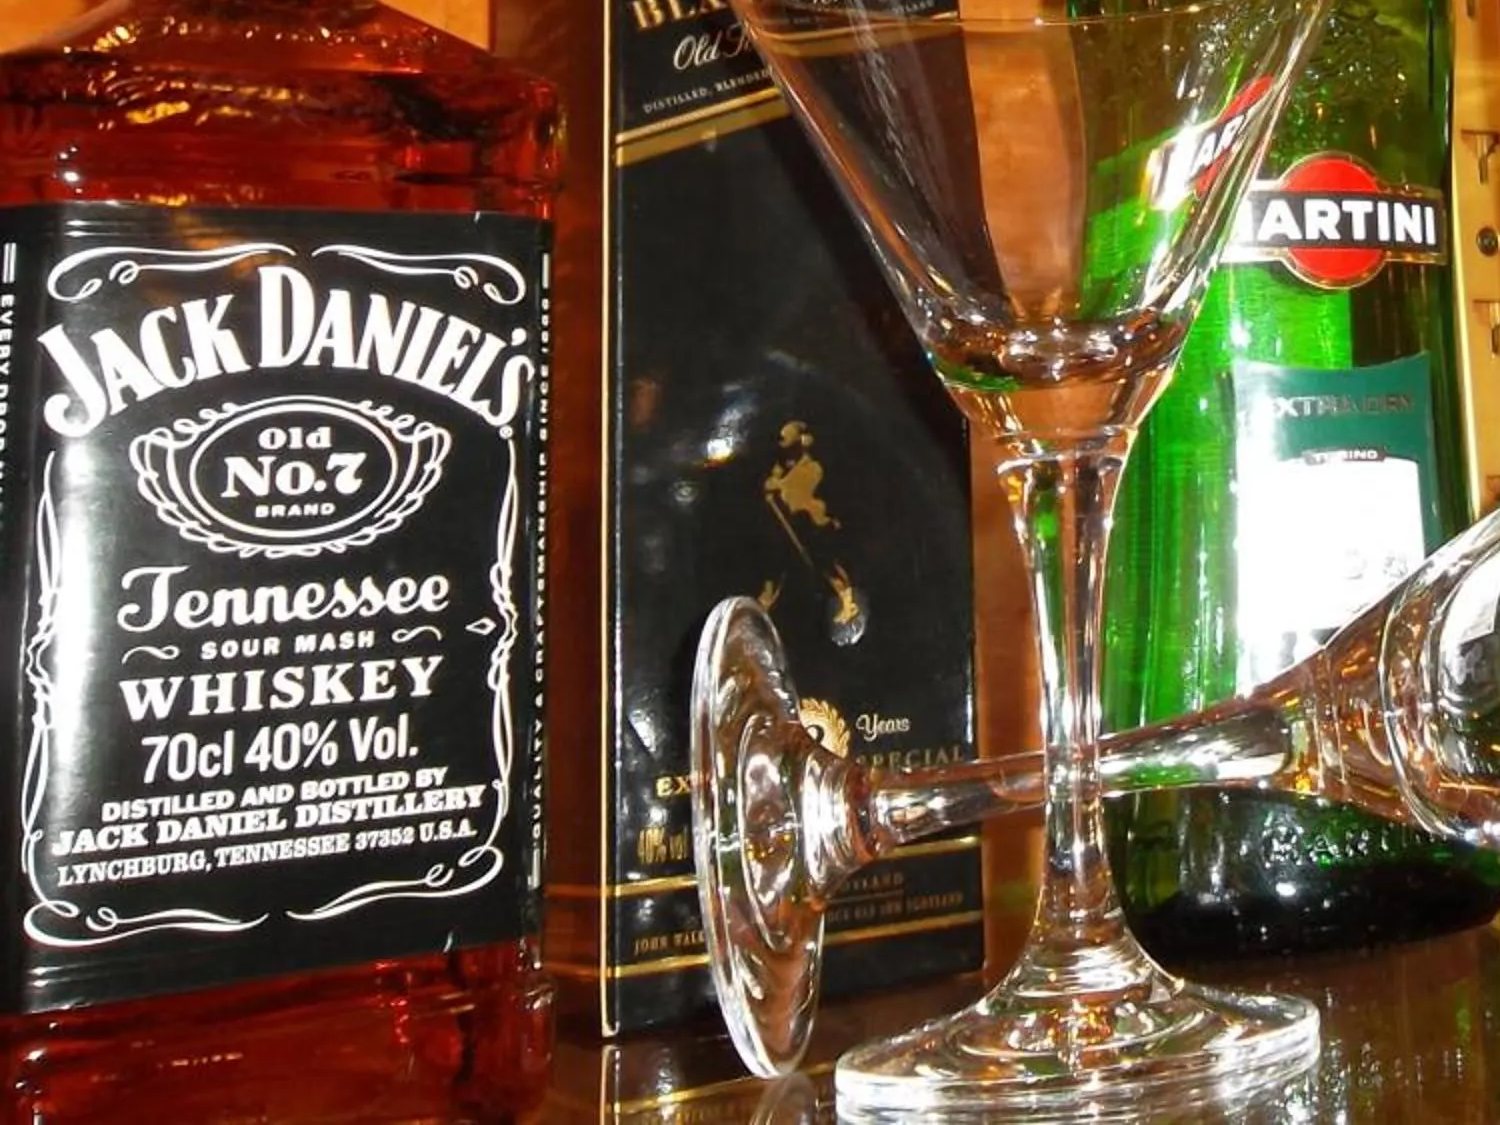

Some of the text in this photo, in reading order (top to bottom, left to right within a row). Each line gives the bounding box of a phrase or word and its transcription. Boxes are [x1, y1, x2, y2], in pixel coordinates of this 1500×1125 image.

[673, 29, 723, 70] Old
[1240, 196, 1436, 245] ARTINI
[37, 265, 535, 437] JACK DANIEL'S
[259, 427, 331, 450] Old
[220, 452, 367, 499] No.7
[255, 502, 336, 519] BRAND
[117, 565, 450, 633] Tennessee
[201, 630, 375, 660] SOUR MASH
[119, 655, 444, 723] WHISKEY
[141, 713, 419, 784] 70cl 40% Vol.
[856, 713, 911, 742] Years
[51, 784, 488, 857] JACK DANIEL DISTILLERY
[101, 767, 449, 824] DISTILLED AND BOTTLED BY
[56, 818, 478, 887] LYNCHBURG, TENNESSEE 37352 U.S.A.
